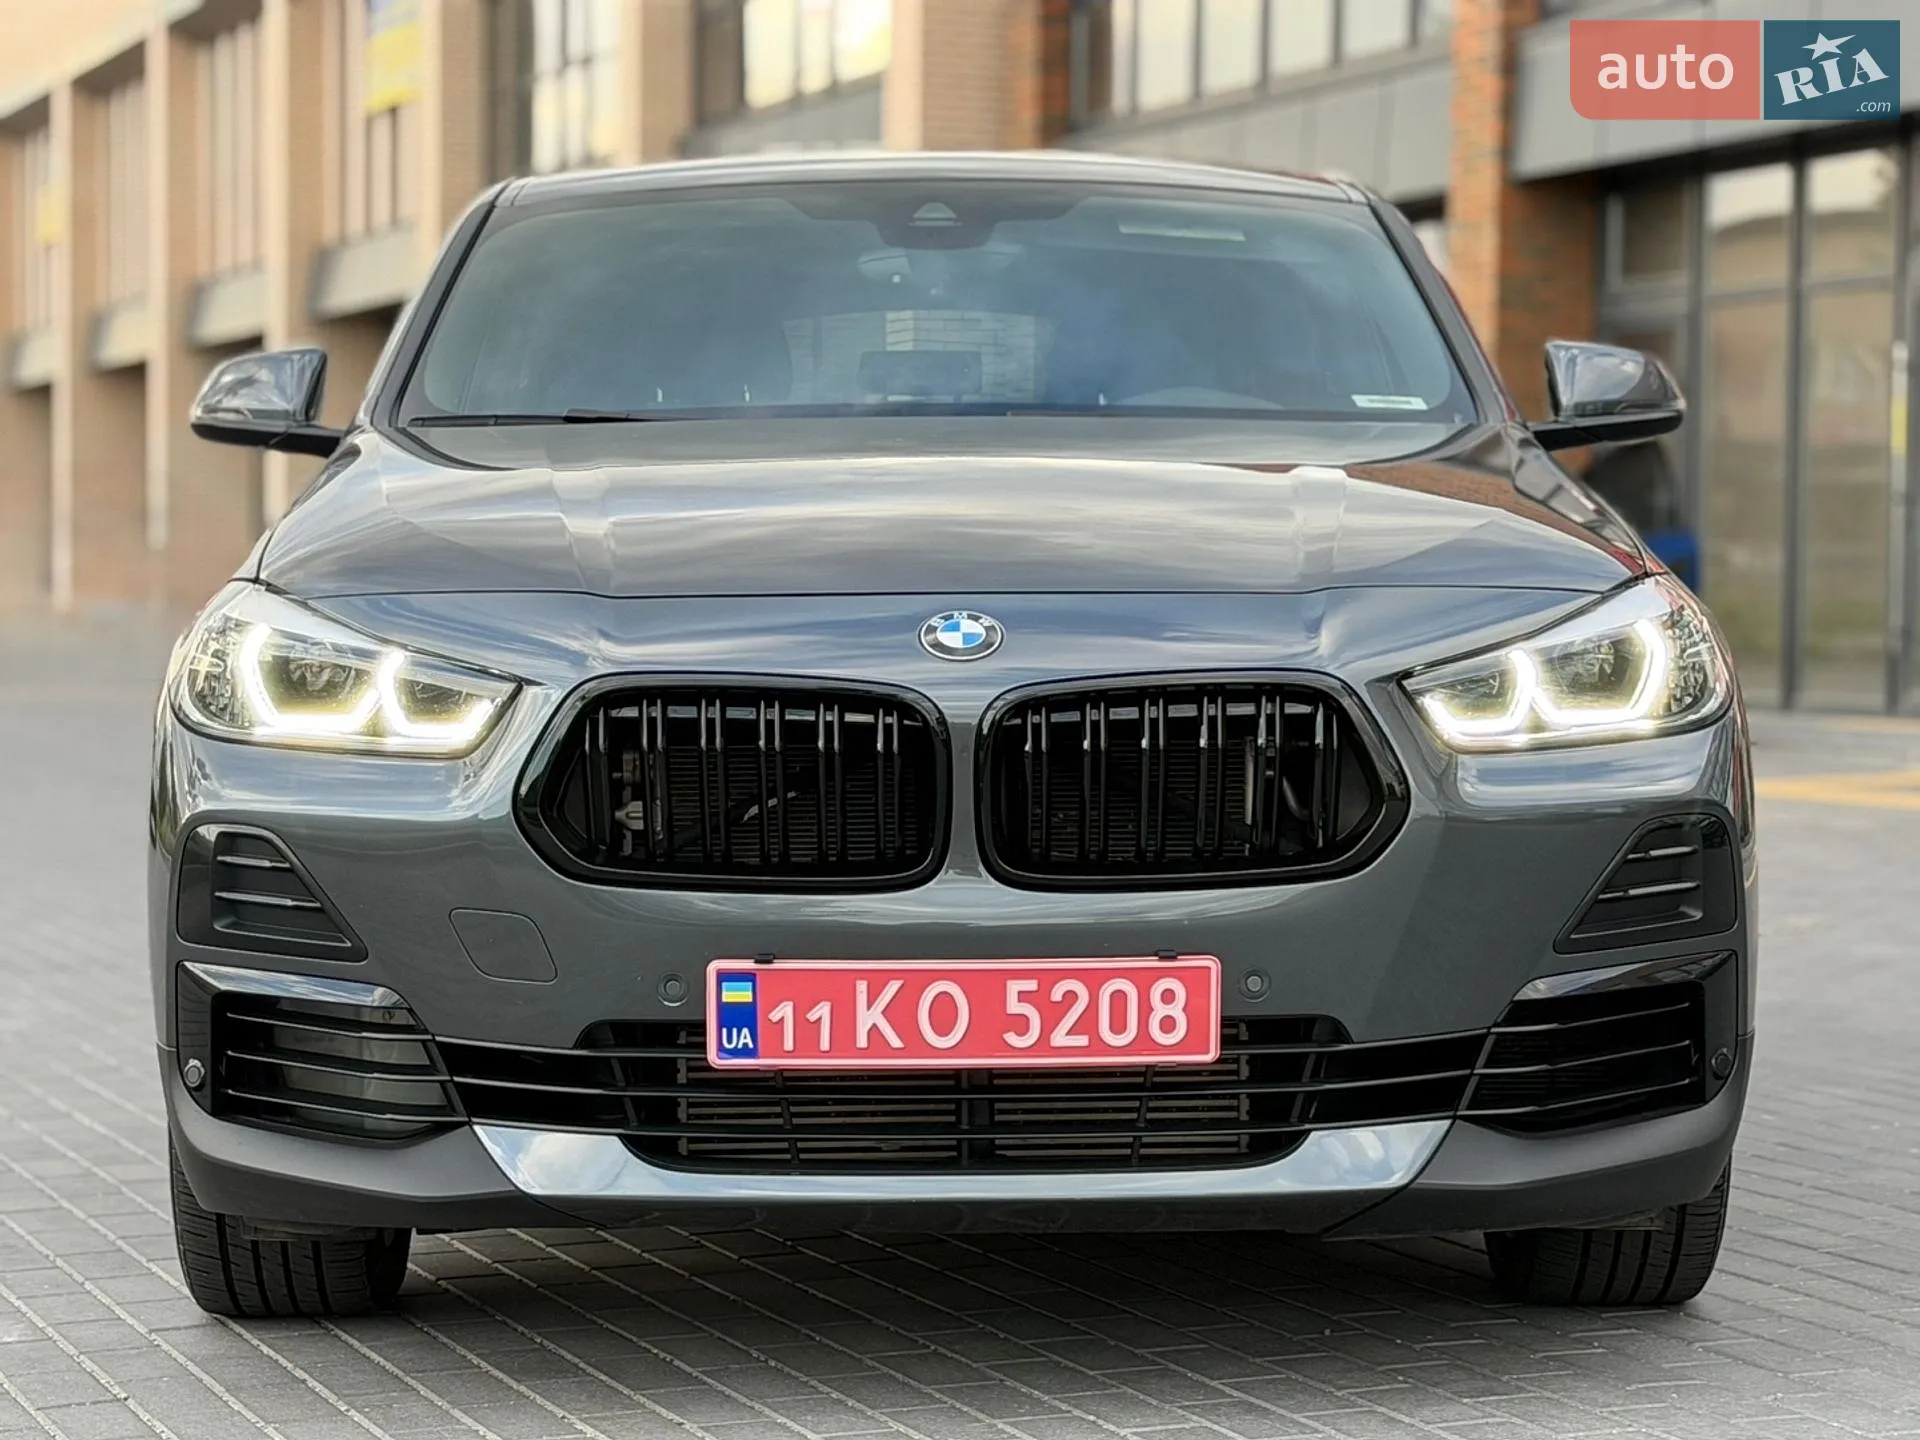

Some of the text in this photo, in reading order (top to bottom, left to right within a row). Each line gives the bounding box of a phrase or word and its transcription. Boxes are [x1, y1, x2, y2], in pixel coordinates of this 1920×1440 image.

[855, 979, 971, 1049] KO
[1002, 977, 1188, 1049] 5208
[722, 1028, 754, 1050] UA
